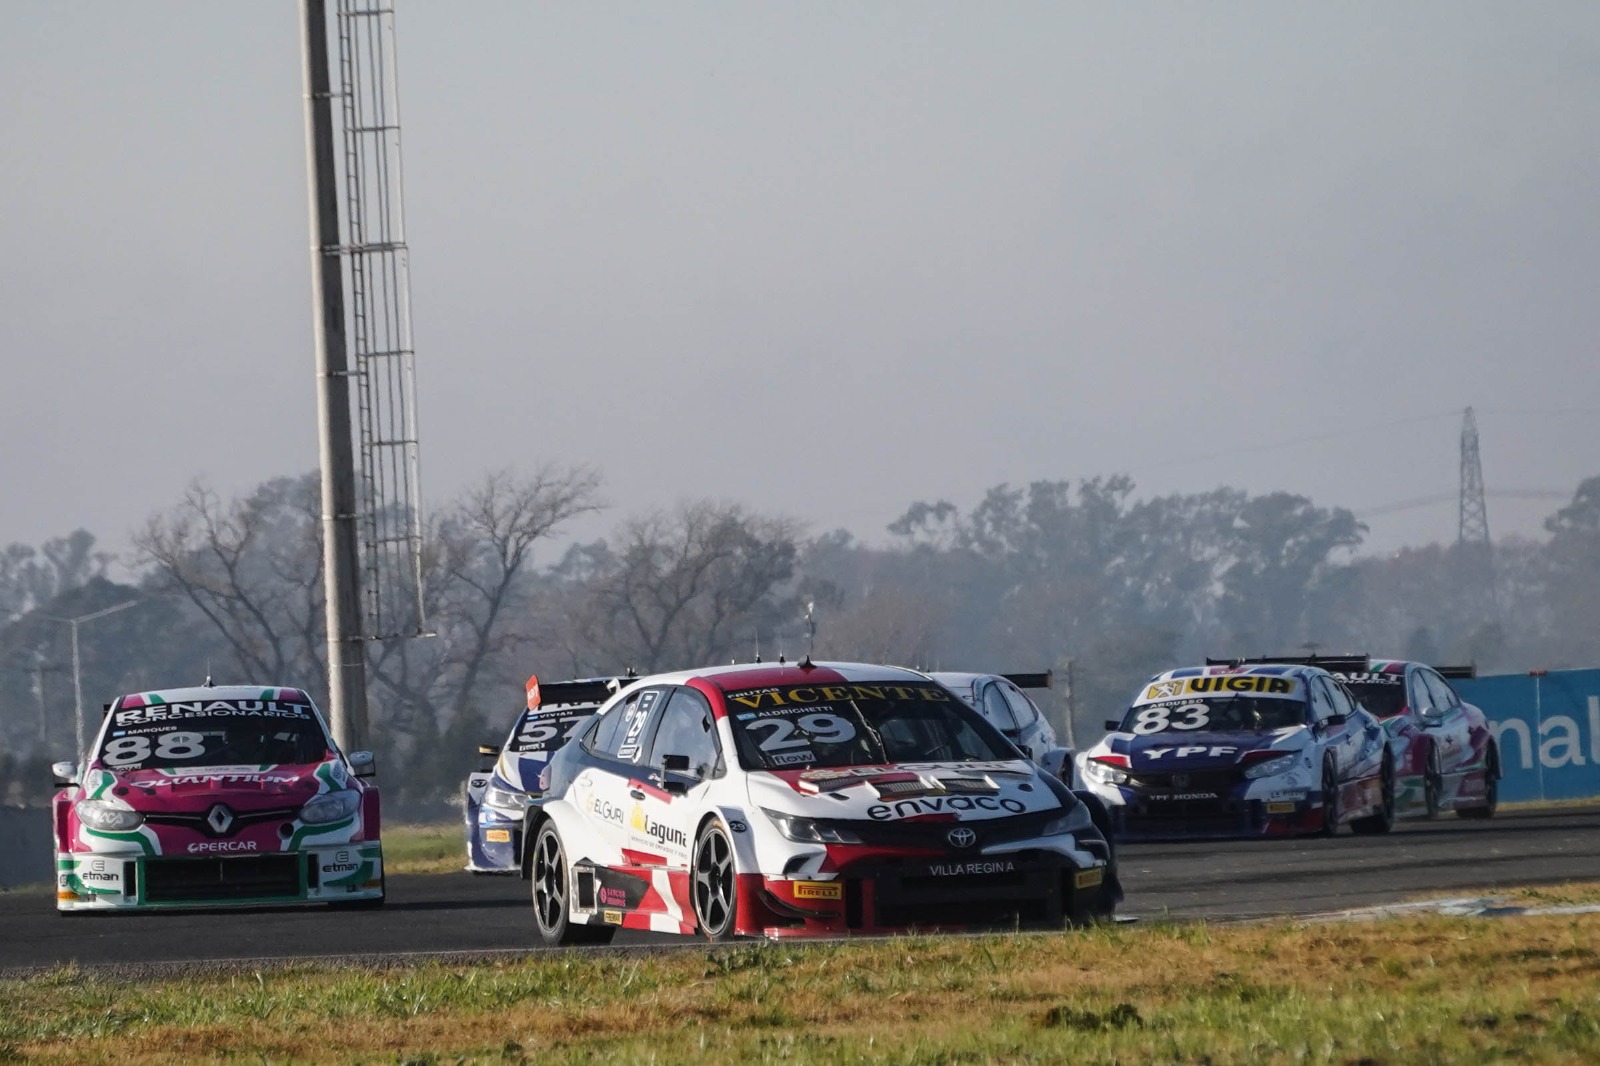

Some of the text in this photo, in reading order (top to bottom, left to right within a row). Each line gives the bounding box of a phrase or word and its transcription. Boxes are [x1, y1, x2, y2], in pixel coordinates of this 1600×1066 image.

[727, 687, 780, 699] FRUTAS
[731, 686, 950, 709] VICENTE
[116, 701, 311, 723] RENAULT
[117, 710, 311, 727] CONCESIONARIOS
[540, 711, 573, 719] VIVIAN
[758, 705, 833, 718] ALDRIGHETTI
[1133, 703, 1210, 735] 83
[128, 726, 177, 735] MARQUES
[518, 715, 596, 743] 57
[746, 713, 856, 752] 29
[102, 731, 206, 766] 88
[1142, 746, 1238, 760] YPF
[774, 753, 815, 765] flow
[131, 774, 299, 788] QUANTIUM
[1173, 792, 1218, 800] HONDA
[867, 797, 1026, 820] envaco
[730, 822, 746, 831] 29
[929, 865, 965, 876] VILLA
[798, 885, 838, 896] PIRELLI
